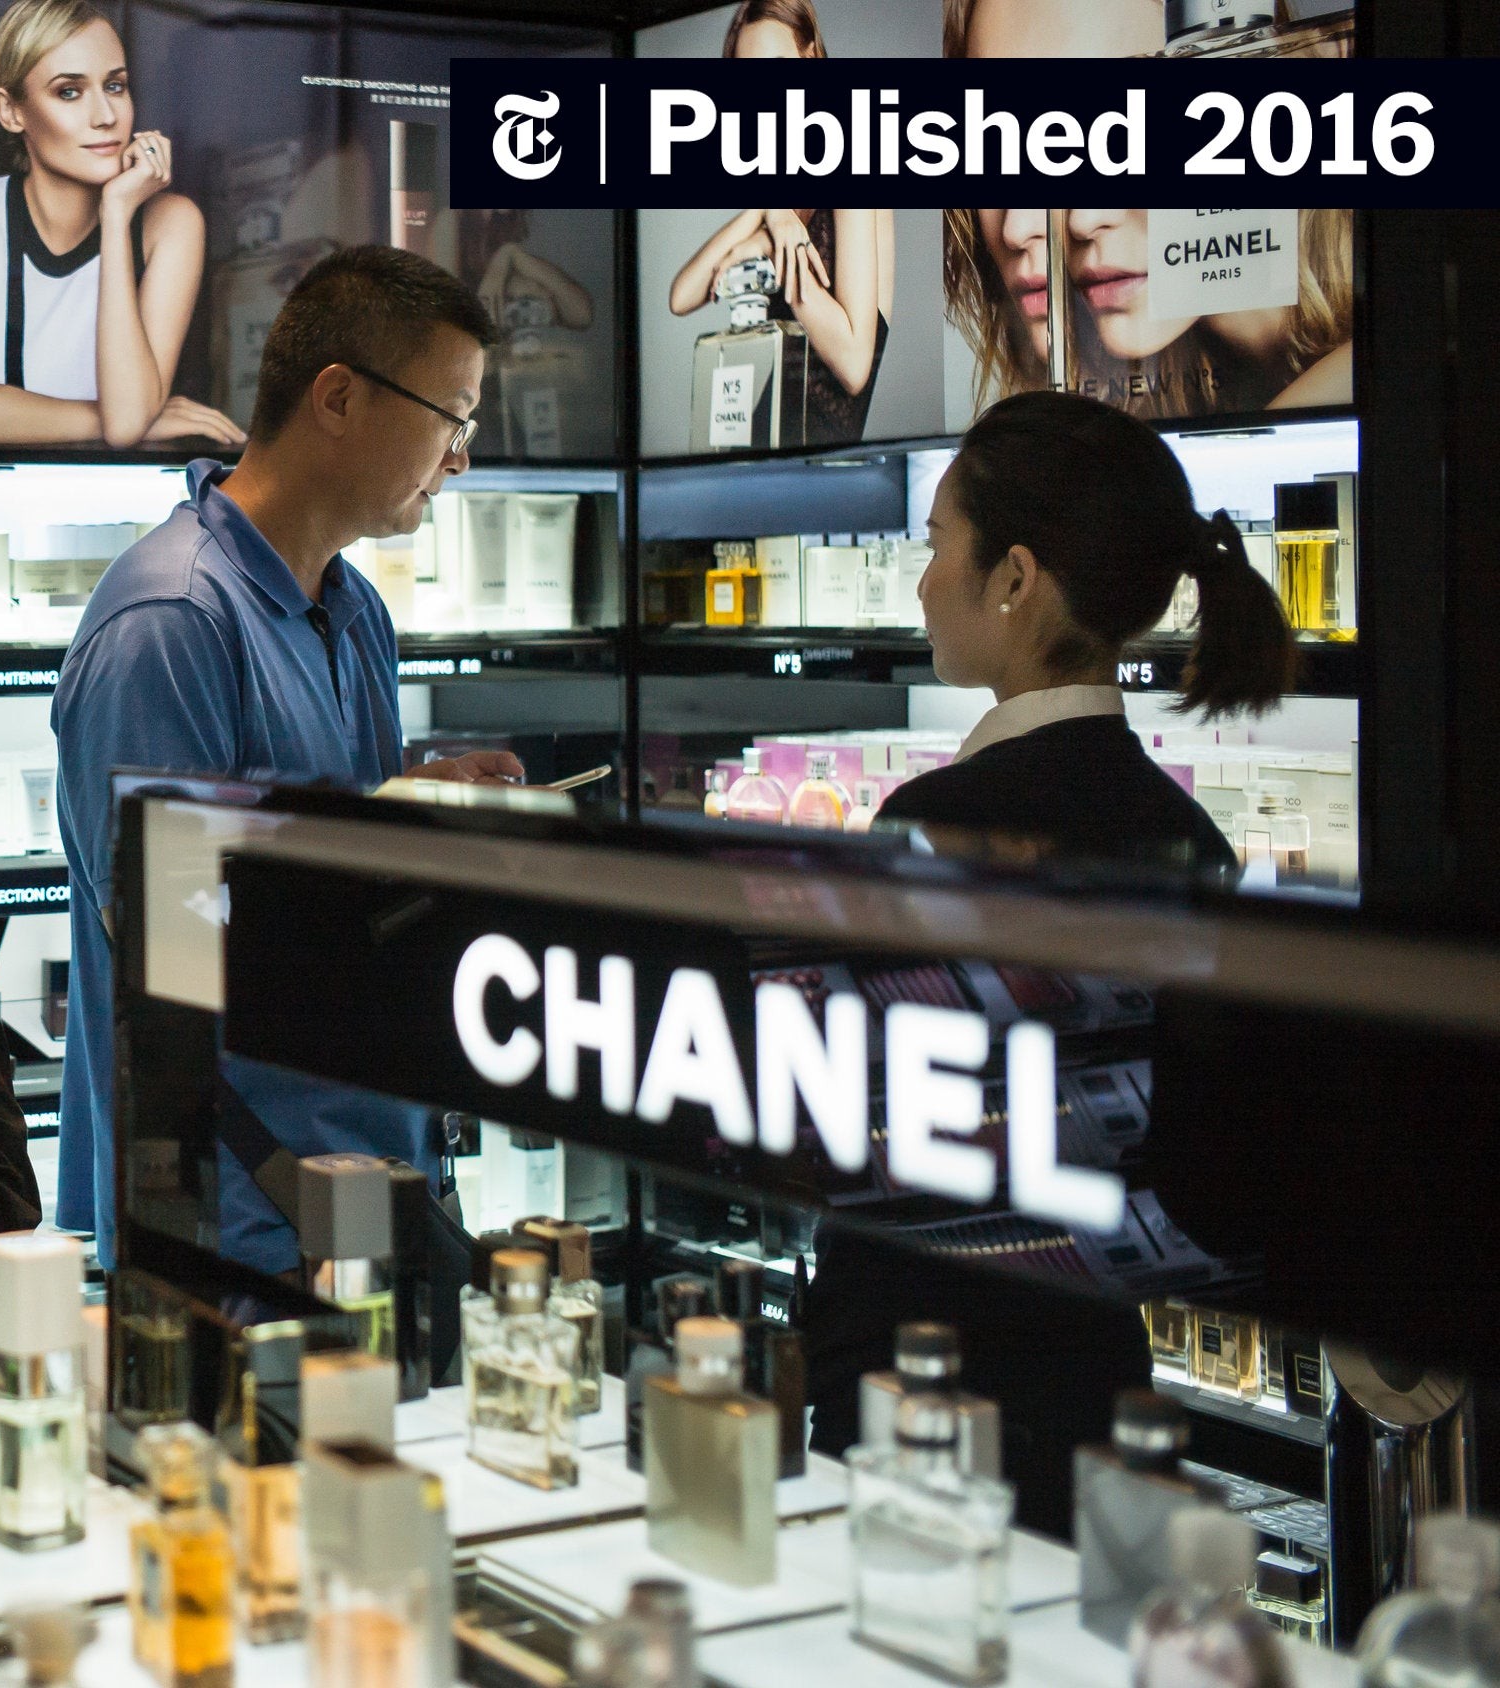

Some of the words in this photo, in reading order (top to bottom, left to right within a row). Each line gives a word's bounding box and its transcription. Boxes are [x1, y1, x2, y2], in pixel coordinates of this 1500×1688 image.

[1163, 228, 1281, 267] CHANEL
[1202, 267, 1241, 282] PARIS
[1284, 797, 1302, 807] CO
[452, 932, 1127, 1235] CHANEL
